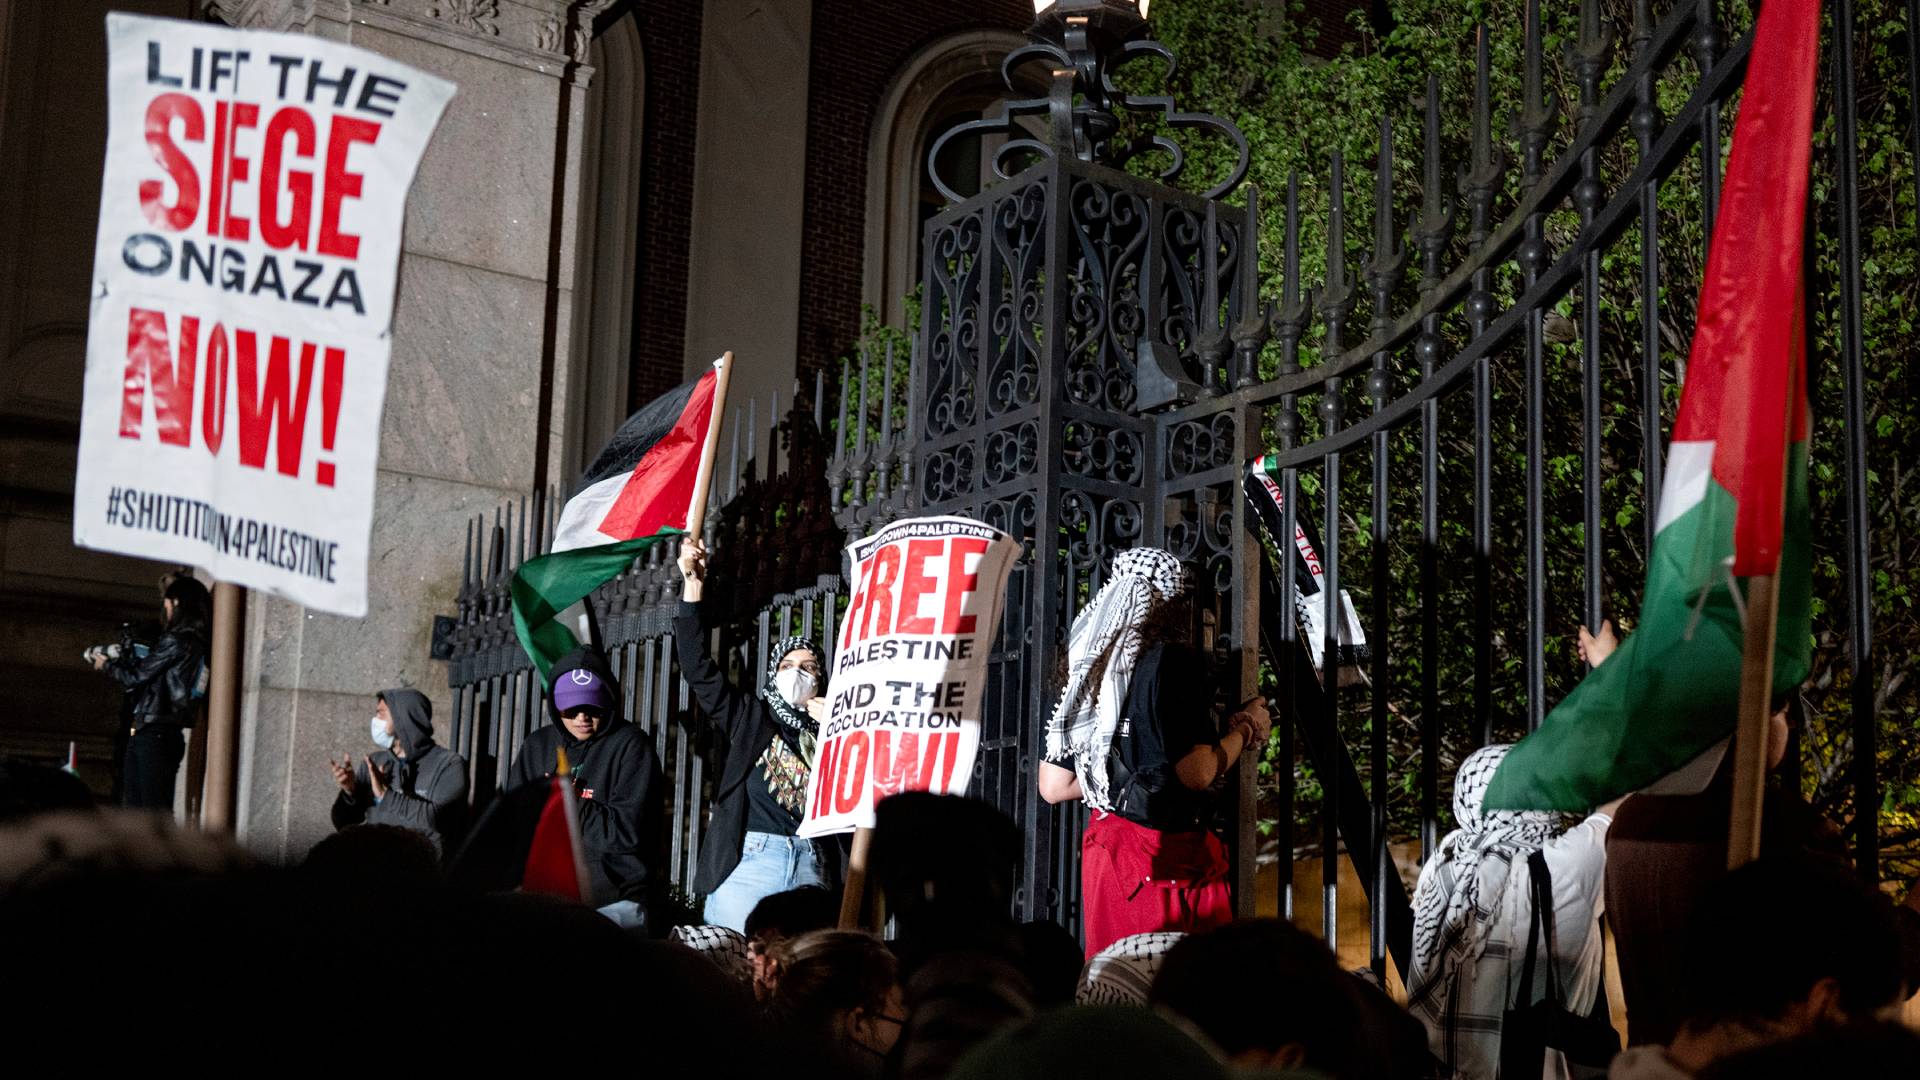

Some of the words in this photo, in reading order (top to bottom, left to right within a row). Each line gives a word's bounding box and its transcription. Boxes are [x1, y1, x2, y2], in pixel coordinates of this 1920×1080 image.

[146, 41, 250, 94] LIFT
[269, 56, 407, 118] THE
[138, 92, 382, 261] SIEGE
[119, 307, 346, 489] NOW!
[844, 537, 989, 650] FREE
[840, 639, 973, 675] PALESTINE
[826, 710, 961, 738] OCCUPATION
[831, 683, 876, 718] END
[886, 680, 966, 707] THE
